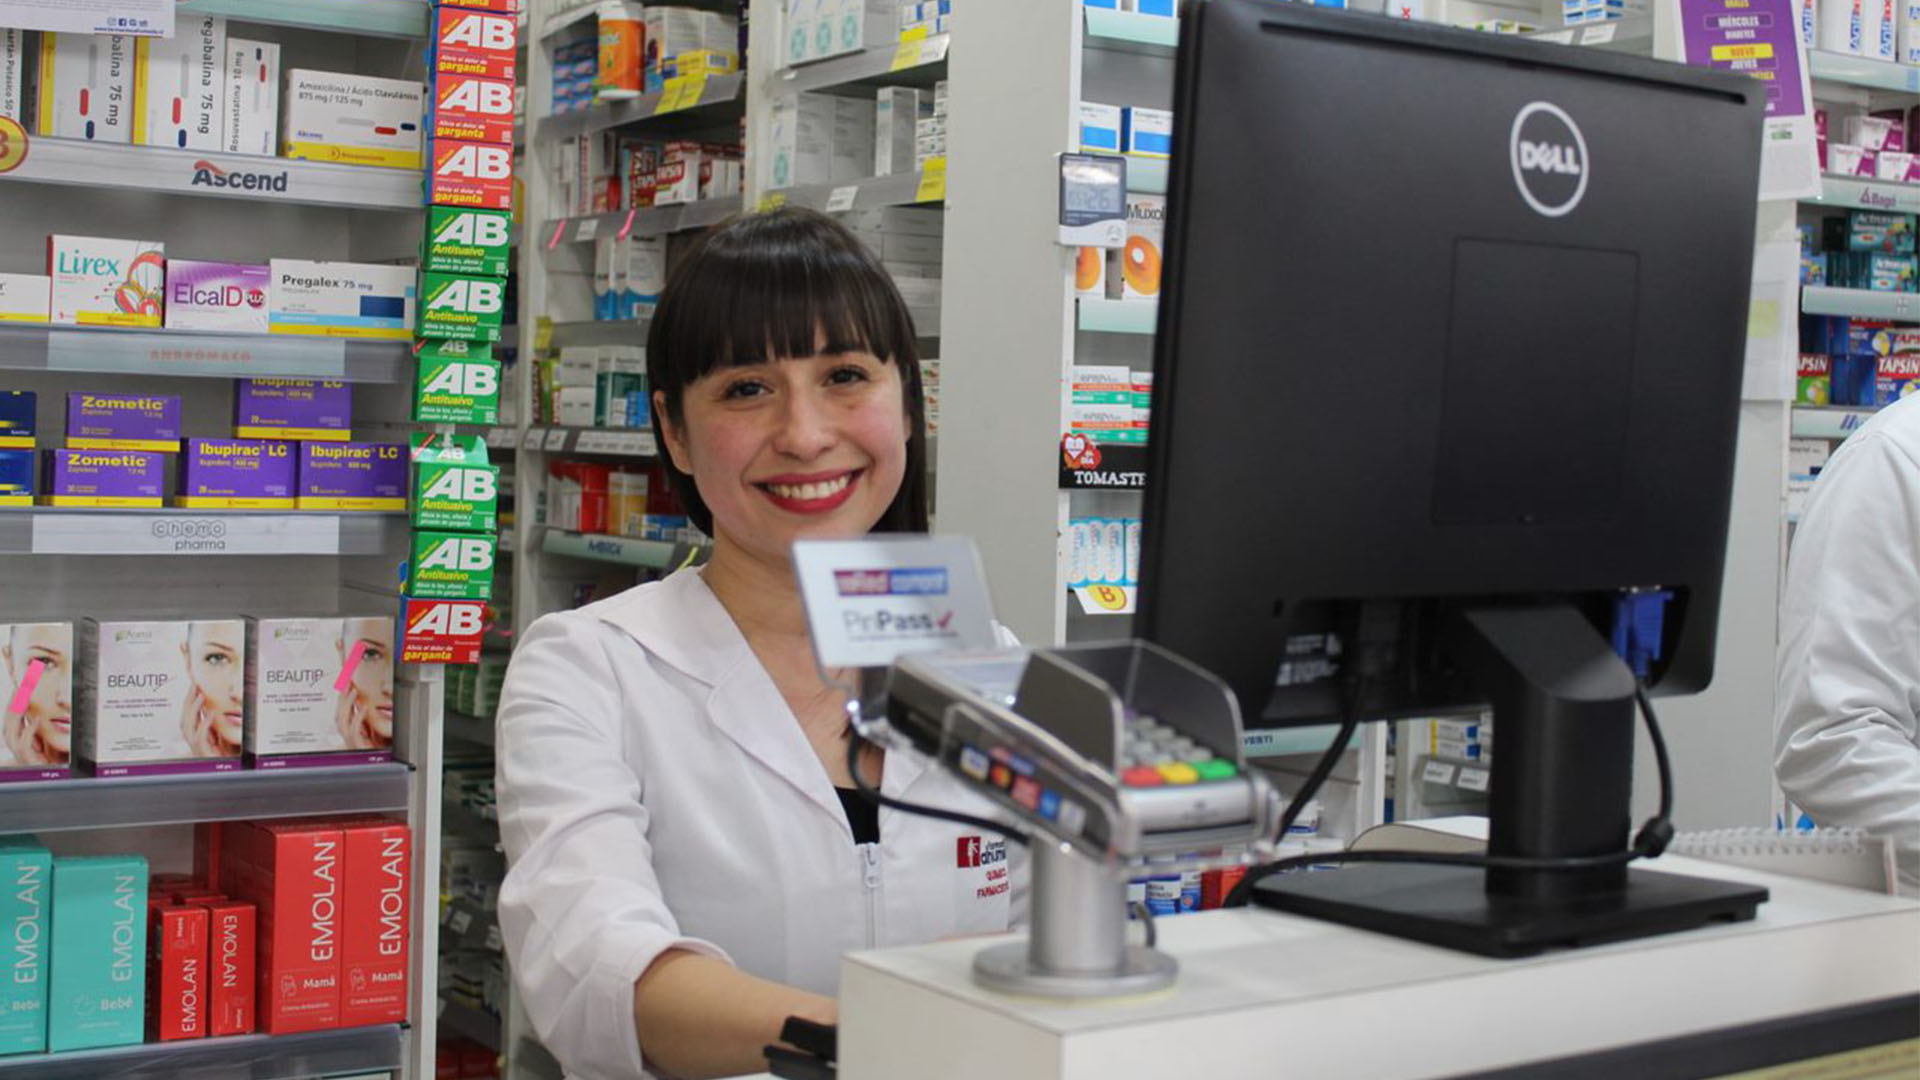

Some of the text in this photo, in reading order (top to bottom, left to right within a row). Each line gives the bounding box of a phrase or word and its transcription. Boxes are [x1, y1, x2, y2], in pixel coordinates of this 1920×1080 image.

[440, 15, 515, 50] AB
[439, 61, 487, 73] garganta
[109, 85, 122, 101] 75
[229, 85, 241, 152] Rosuvastatina
[235, 51, 244, 67] mg
[299, 92, 313, 101] 875
[315, 94, 328, 103] mg
[335, 95, 349, 104] 125
[350, 98, 364, 107] mg
[438, 80, 513, 115] AB
[201, 94, 213, 110] 75
[106, 104, 120, 127] mg
[198, 113, 211, 135] mg
[437, 127, 485, 138] garganta
[437, 145, 511, 179] AB
[1520, 141, 1580, 175] DELL
[191, 166, 287, 193] Ascend
[435, 192, 483, 204] garganta
[433, 213, 509, 246] AB
[432, 244, 485, 257] Antitusivo
[59, 250, 120, 277] Lirex
[282, 274, 373, 291] Pregalex 75 mg
[174, 283, 243, 307] ElcalD
[427, 280, 502, 313] AB
[425, 311, 478, 324] Antitusivo
[1878, 357, 1920, 374] TAPSIN
[424, 362, 497, 396] AB
[81, 396, 164, 412] Zometic
[423, 394, 475, 406] Antitusivo
[200, 443, 287, 459] Ibupirac LC
[311, 445, 398, 460] Ibupirac LC
[68, 453, 147, 468] Zometic
[422, 467, 497, 501] AB
[422, 499, 473, 511] Antitusivo
[153, 520, 225, 537] chemo
[175, 539, 226, 552] pharma
[419, 538, 493, 571] AB
[418, 569, 469, 581] Antitusivo
[407, 603, 483, 635] AB
[404, 651, 453, 662] garganta
[311, 840, 335, 962] EMOLAN
[380, 836, 404, 956] EMOLAN
[14, 865, 41, 984] EMOLAN
[112, 873, 137, 981] EMOLAN
[223, 915, 238, 989] EMOLAN
[303, 974, 335, 989] Mamá
[372, 970, 403, 983] Mamá
[101, 996, 134, 1011] Bebé
[181, 958, 198, 1033] EMOLAN
